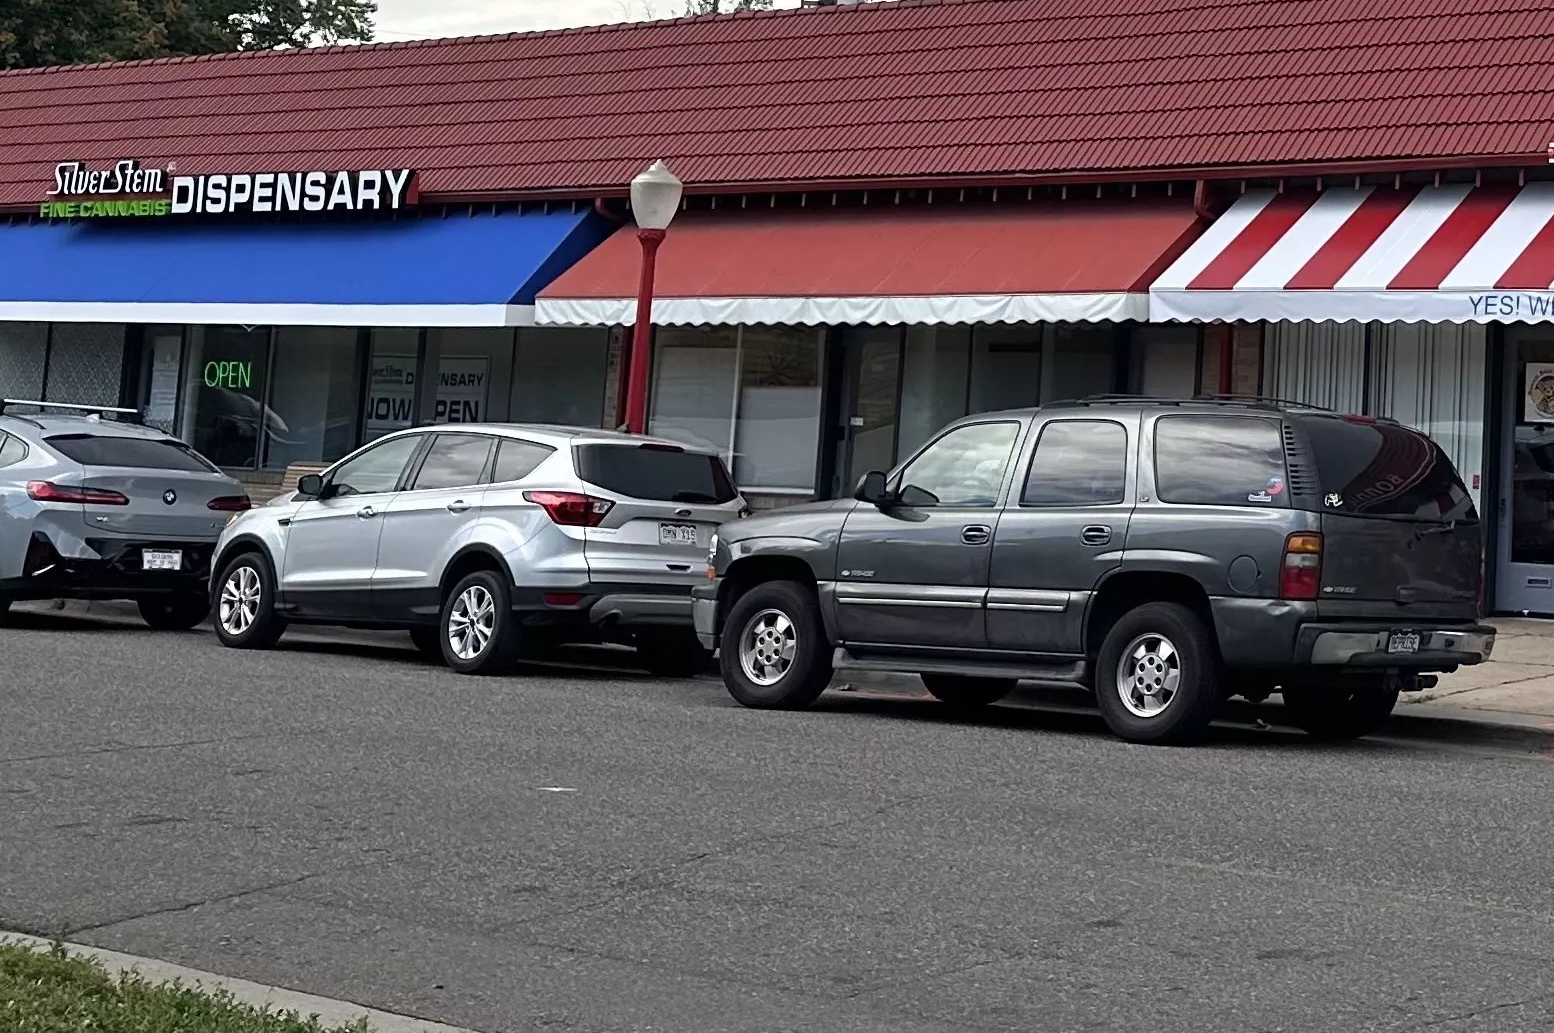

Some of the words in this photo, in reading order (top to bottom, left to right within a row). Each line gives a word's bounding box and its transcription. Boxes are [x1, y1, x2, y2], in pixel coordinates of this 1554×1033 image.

[171, 169, 410, 214] DISPENSARY
[40, 203, 76, 217] FINE
[80, 200, 168, 217] CANNABIS
[1469, 295, 1520, 316] YES!
[204, 361, 252, 389] OPEN
[435, 399, 479, 423] PEN
